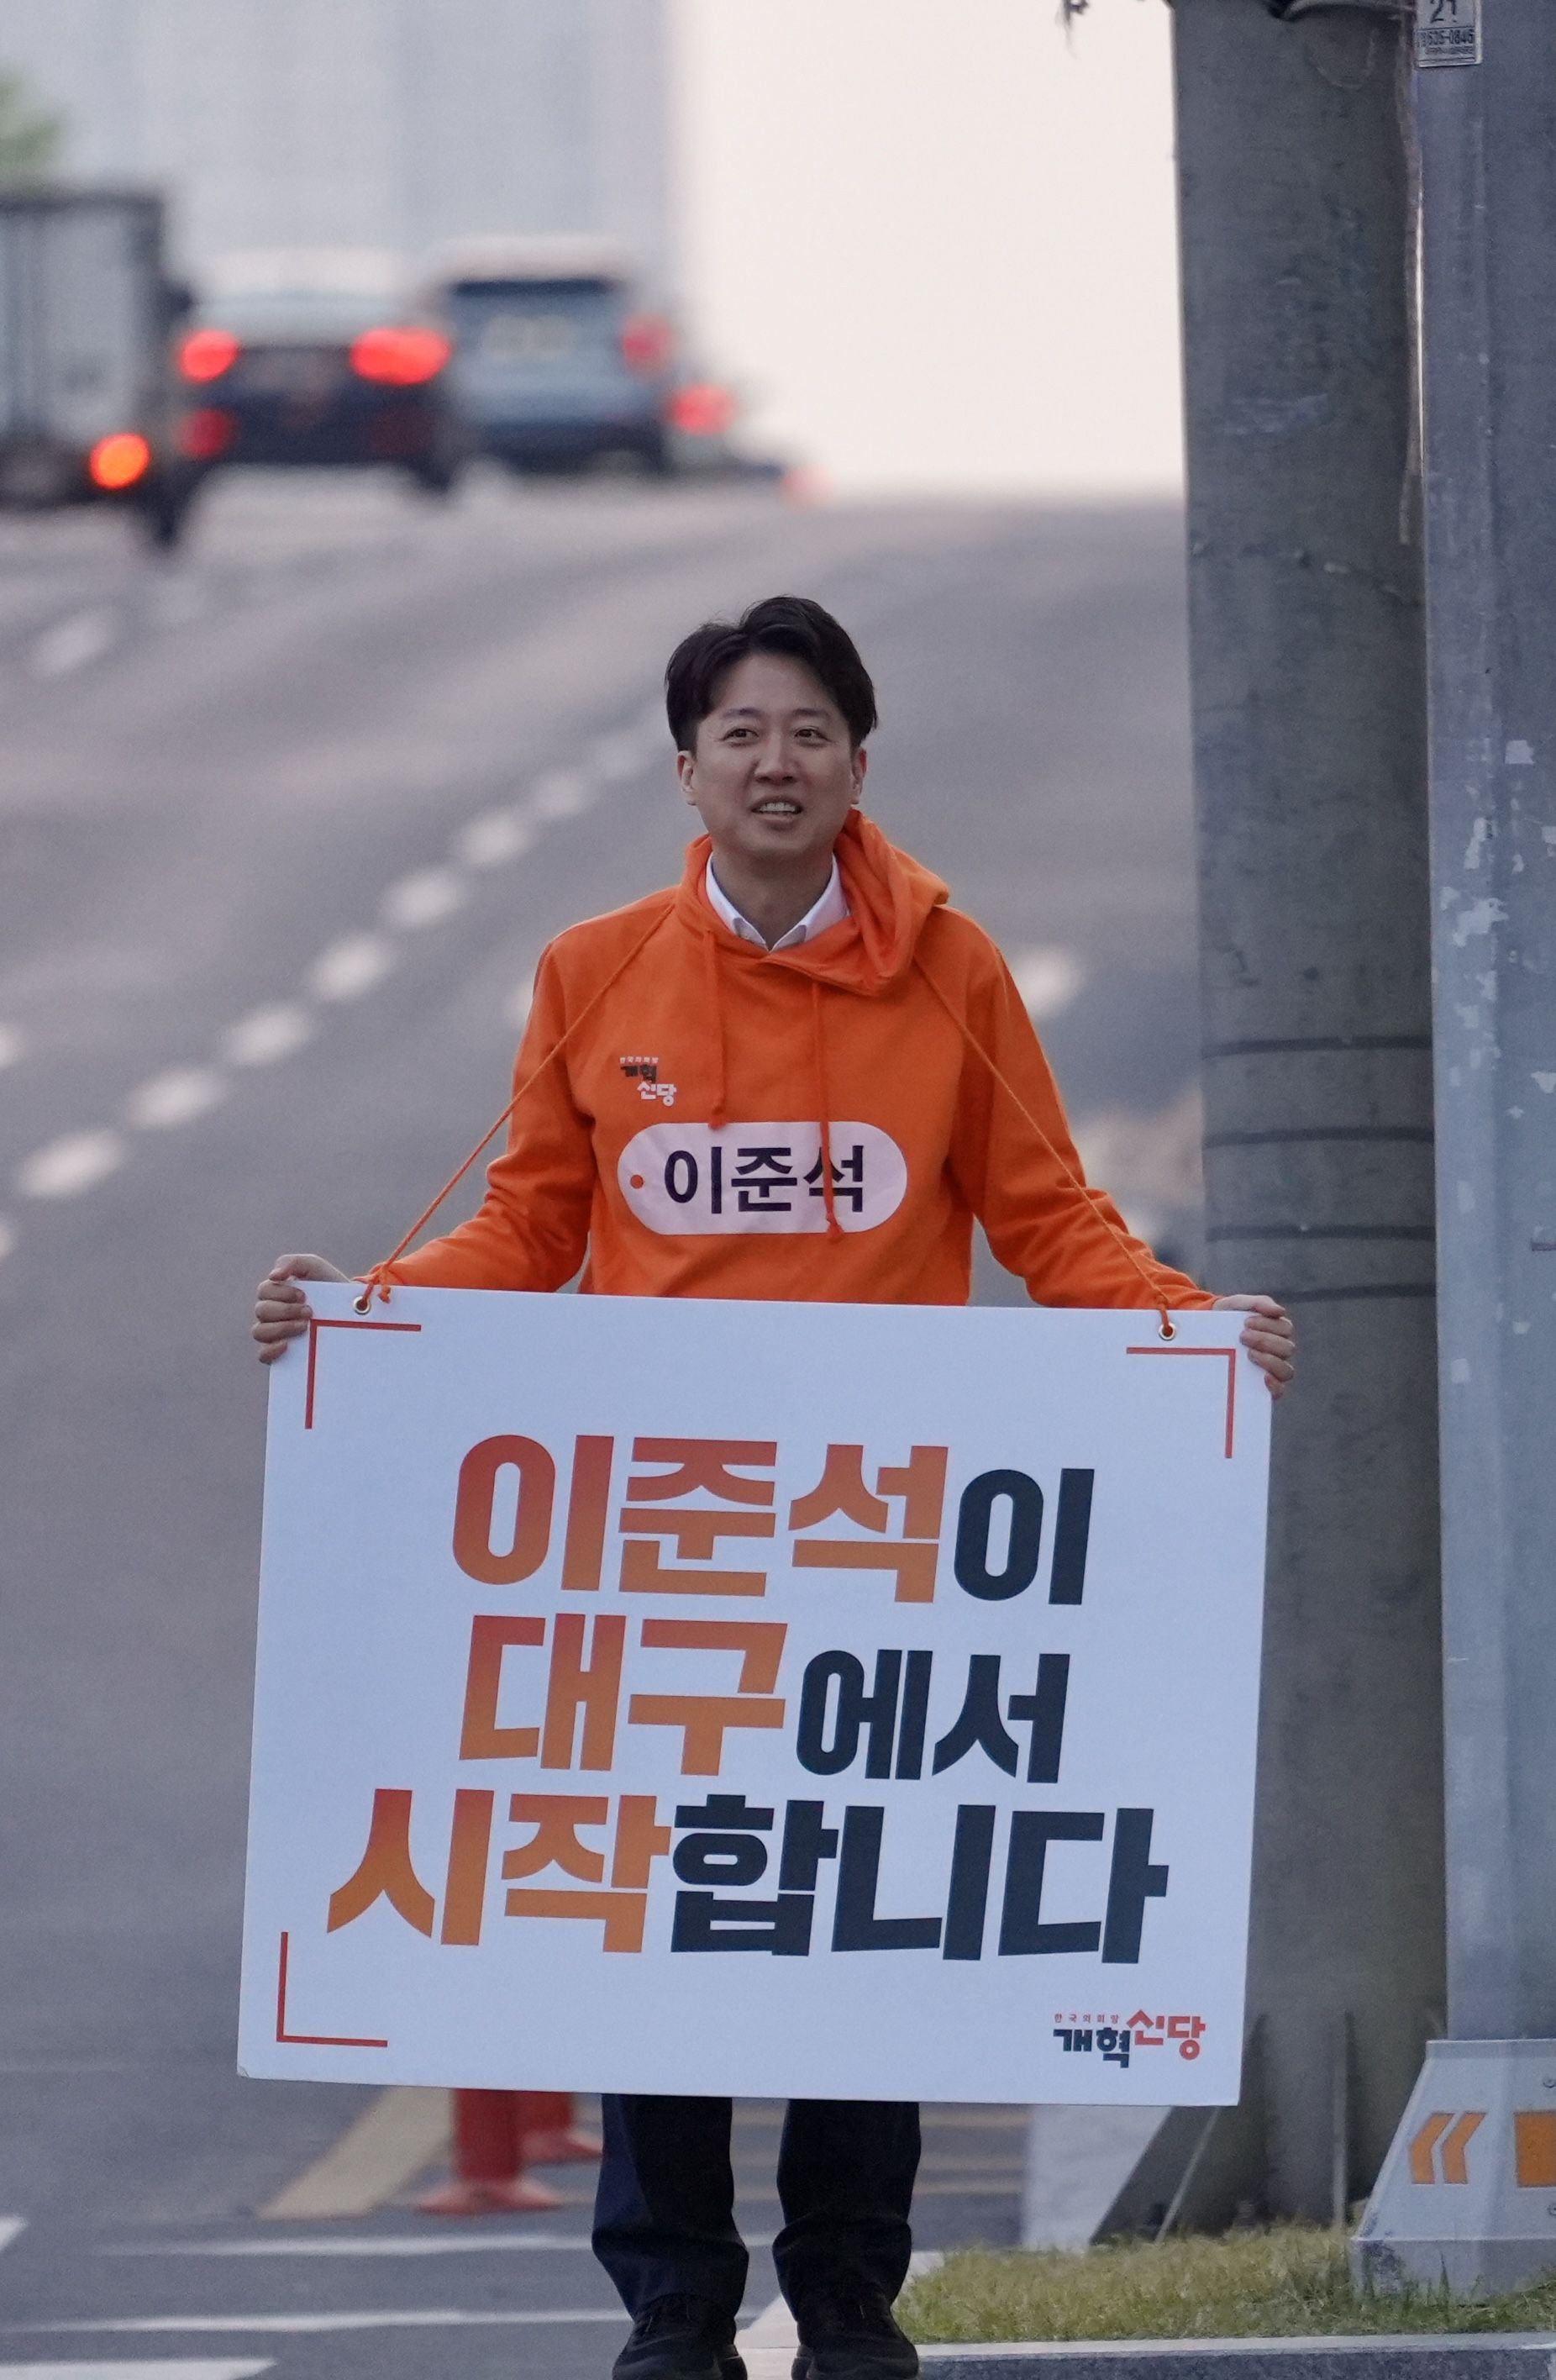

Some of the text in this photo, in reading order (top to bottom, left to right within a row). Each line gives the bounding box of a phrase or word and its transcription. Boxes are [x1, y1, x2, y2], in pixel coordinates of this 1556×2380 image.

[638, 1081, 677, 1107] 신당
[664, 1145, 865, 1214] 이준석
[452, 1434, 1096, 1605] 이준석이
[460, 1614, 1071, 1783] 대구에서
[327, 1788, 1170, 1965] 시작합니다
